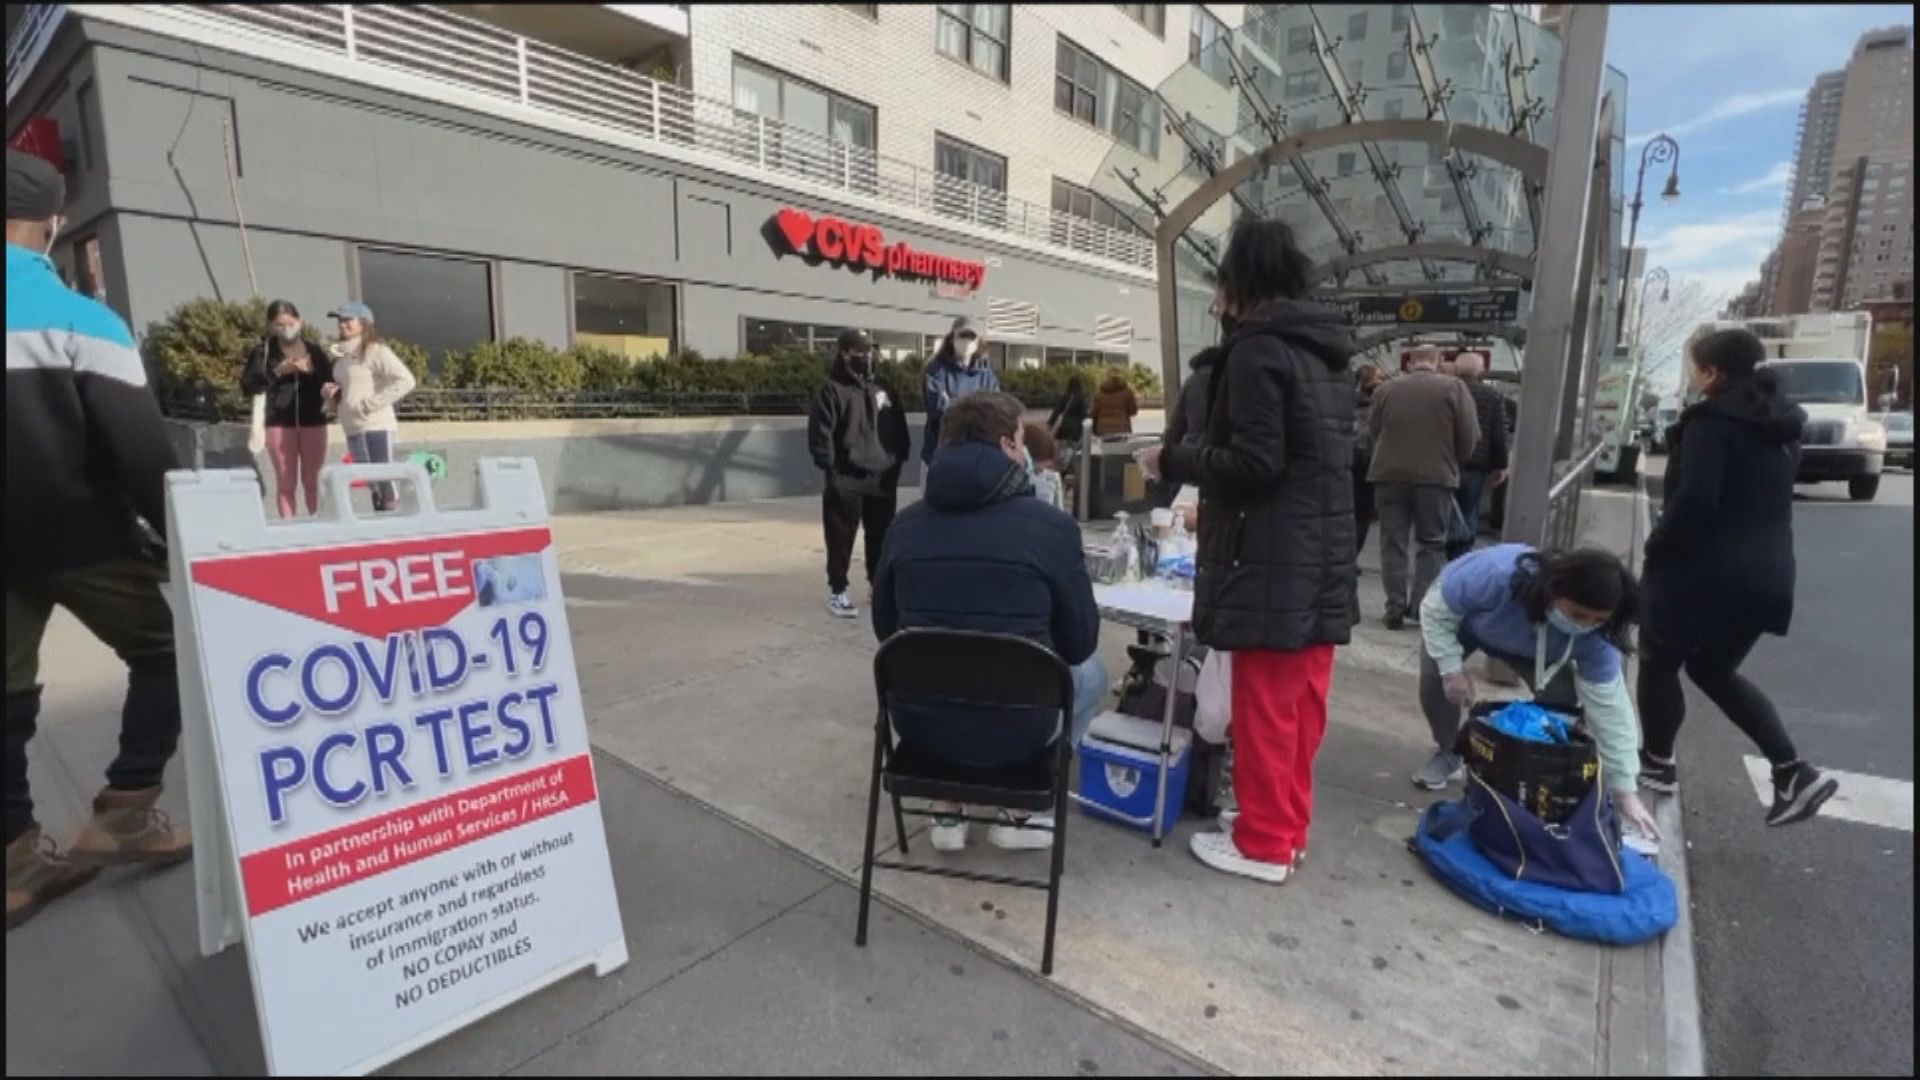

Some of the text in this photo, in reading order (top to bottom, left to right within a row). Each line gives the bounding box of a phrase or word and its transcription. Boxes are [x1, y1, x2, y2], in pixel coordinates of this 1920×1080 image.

[816, 217, 988, 291] CVS pharmacy
[320, 550, 471, 613] FREE
[246, 611, 548, 724] COVID-19
[259, 683, 559, 822] PCR TEST
[285, 768, 564, 870] In partnership with Department of
[287, 790, 570, 895] Health and Human Services / HRSA
[297, 832, 575, 943] We accept anyone with or without
[349, 865, 547, 950] insurance and regardless
[366, 892, 541, 971] of immigration status.
[395, 936, 533, 1009] NO DEDUCTIBLES
[402, 918, 518, 980] NO COPAY and
